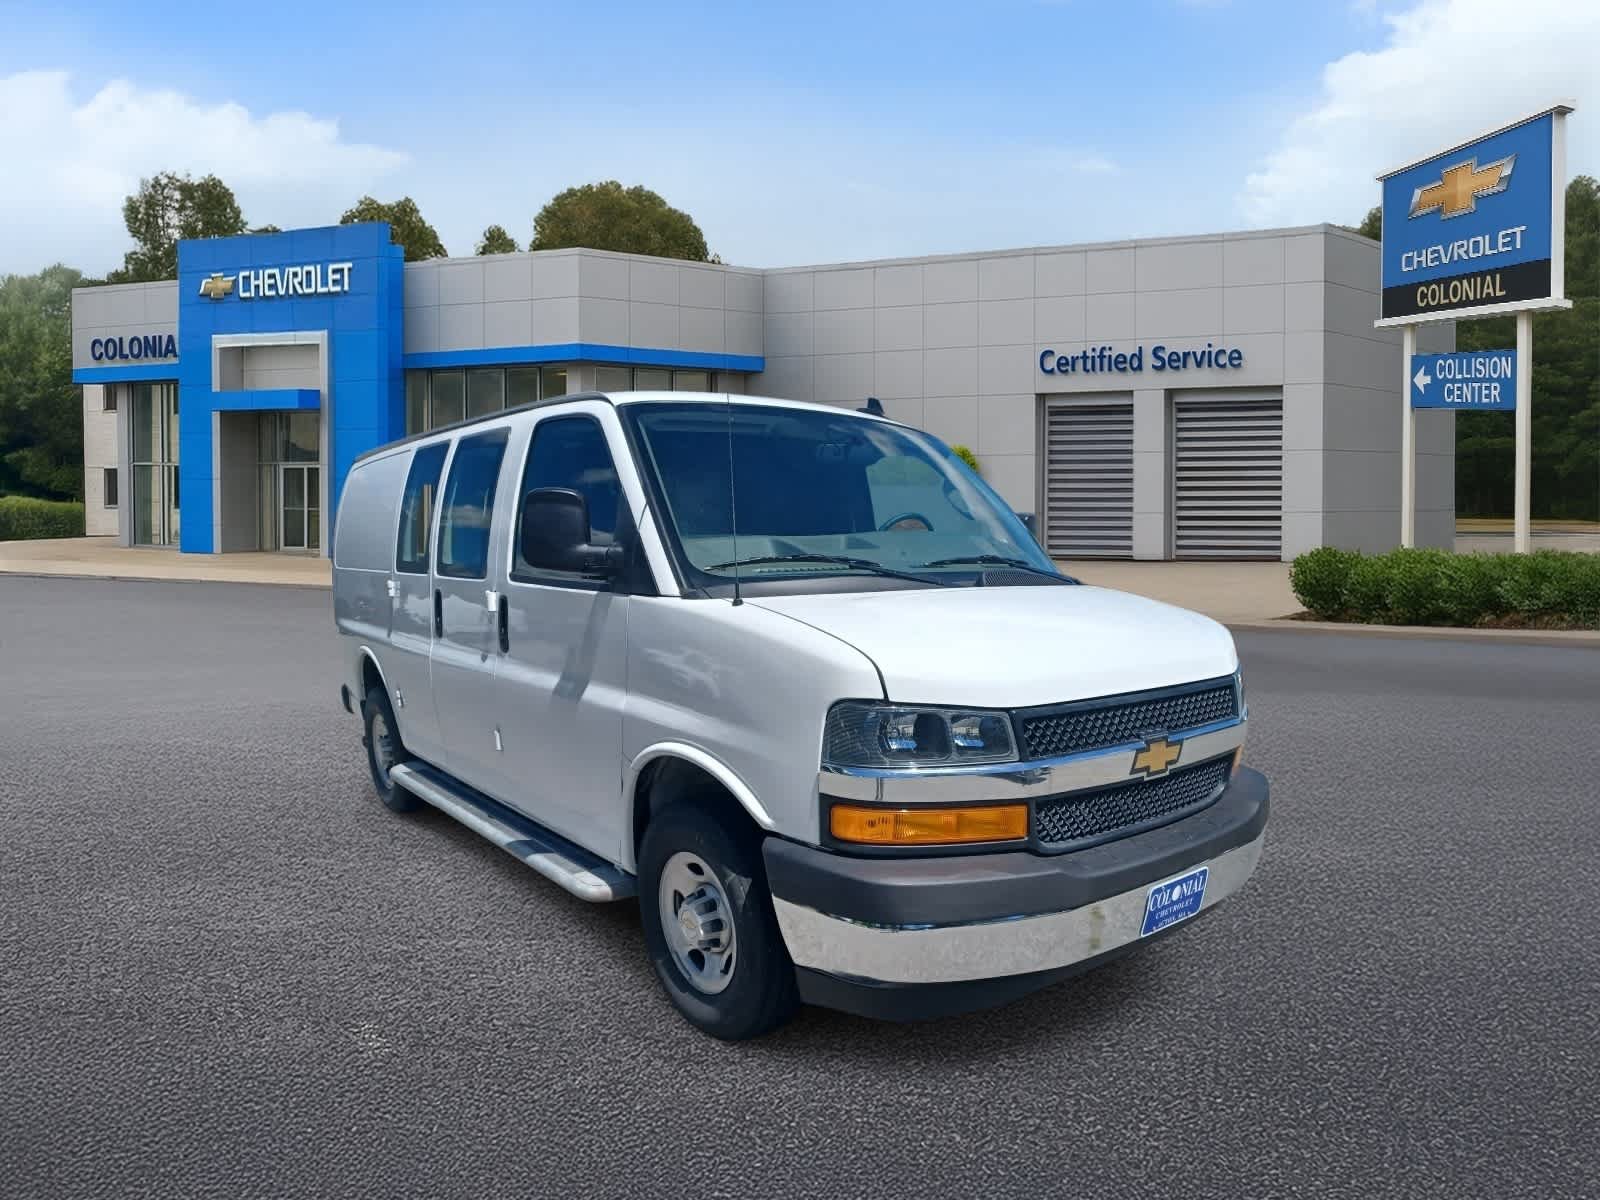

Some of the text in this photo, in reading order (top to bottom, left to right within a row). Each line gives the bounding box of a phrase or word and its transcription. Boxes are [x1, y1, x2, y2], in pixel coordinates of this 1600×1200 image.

[1401, 225, 1528, 272] CHEVROLET
[238, 261, 353, 298] CHEVROLET
[1416, 273, 1506, 307] COLONIAL
[90, 334, 178, 361] COLONIA
[1039, 343, 1243, 374] Certified Service
[1436, 356, 1512, 380] COLLISION
[1444, 383, 1501, 403] CENTER
[1150, 875, 1204, 911] COLONIAL
